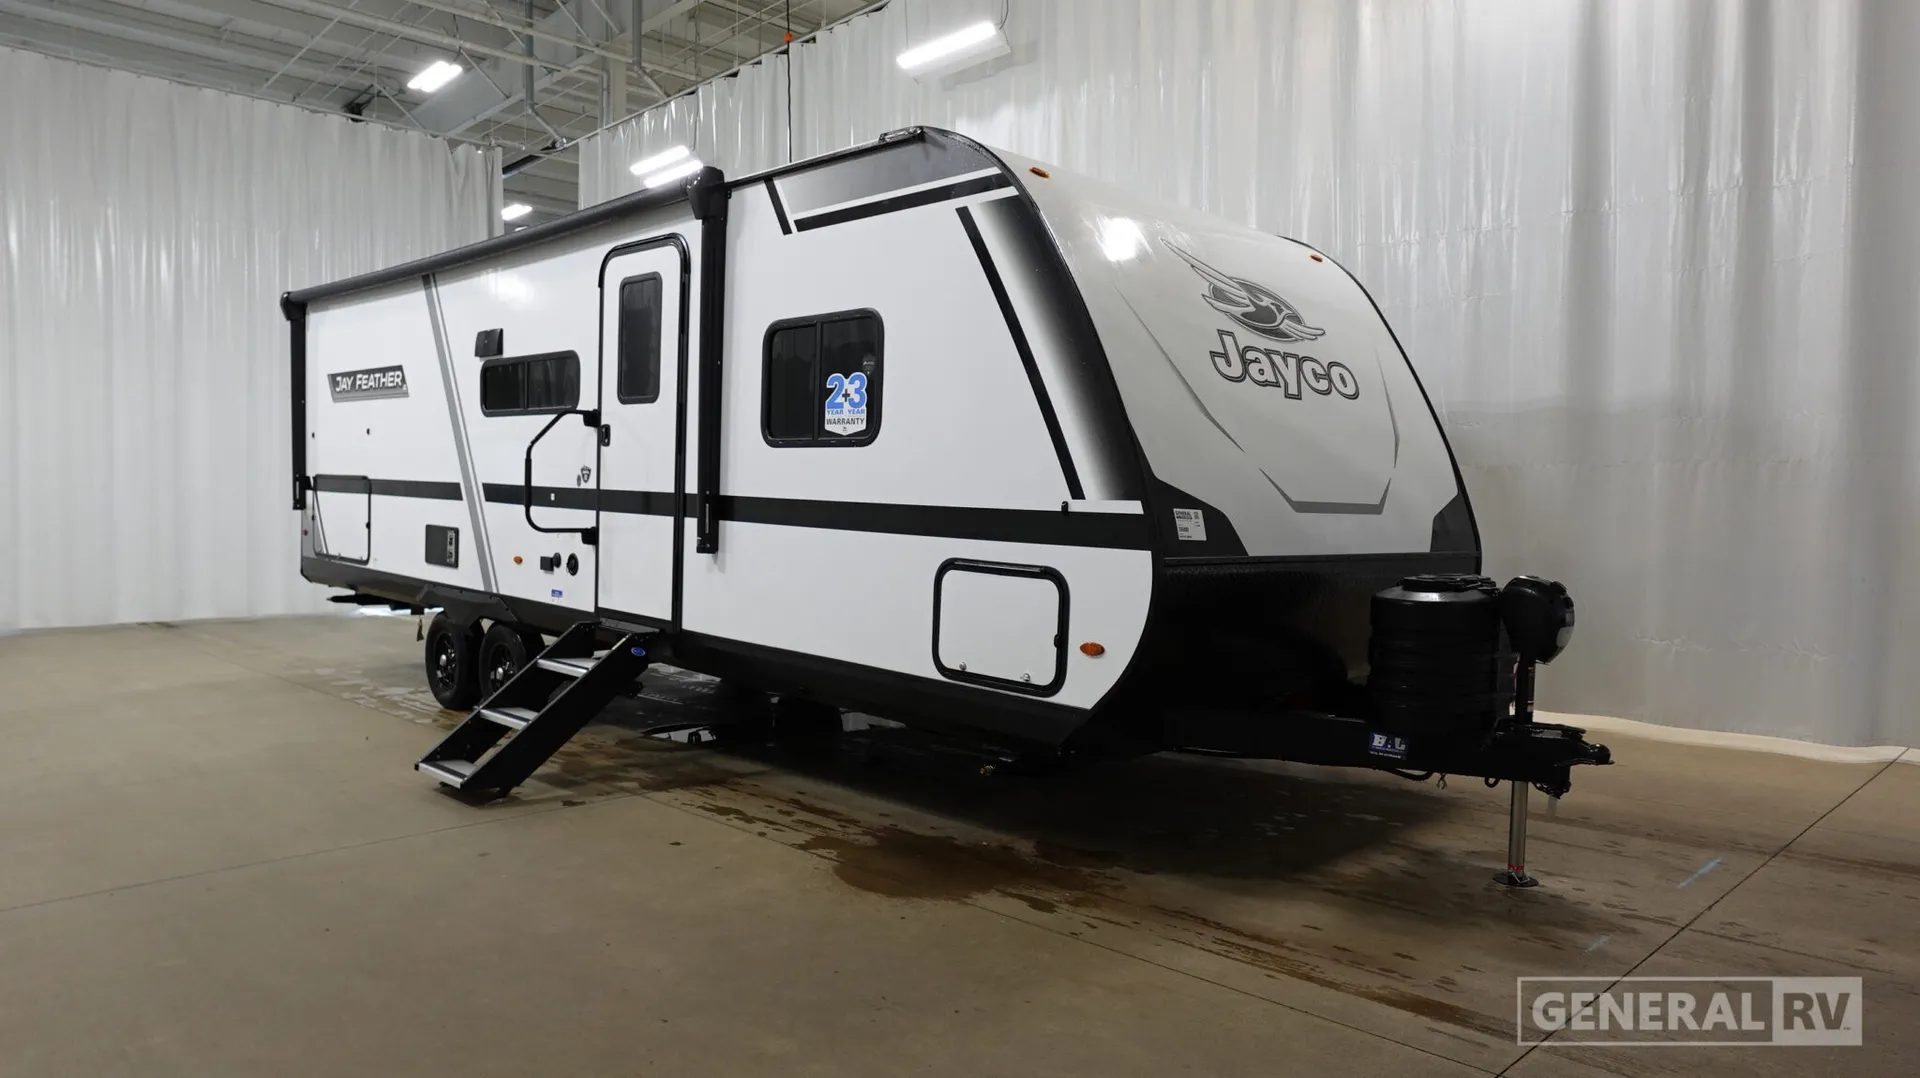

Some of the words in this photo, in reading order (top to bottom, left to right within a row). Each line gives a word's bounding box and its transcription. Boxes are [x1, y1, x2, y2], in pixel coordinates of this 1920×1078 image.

[1209, 329, 1359, 400] Jayco
[335, 375, 354, 392] JAY
[356, 371, 403, 389] FEATHER
[826, 417, 865, 425] WARRANTY
